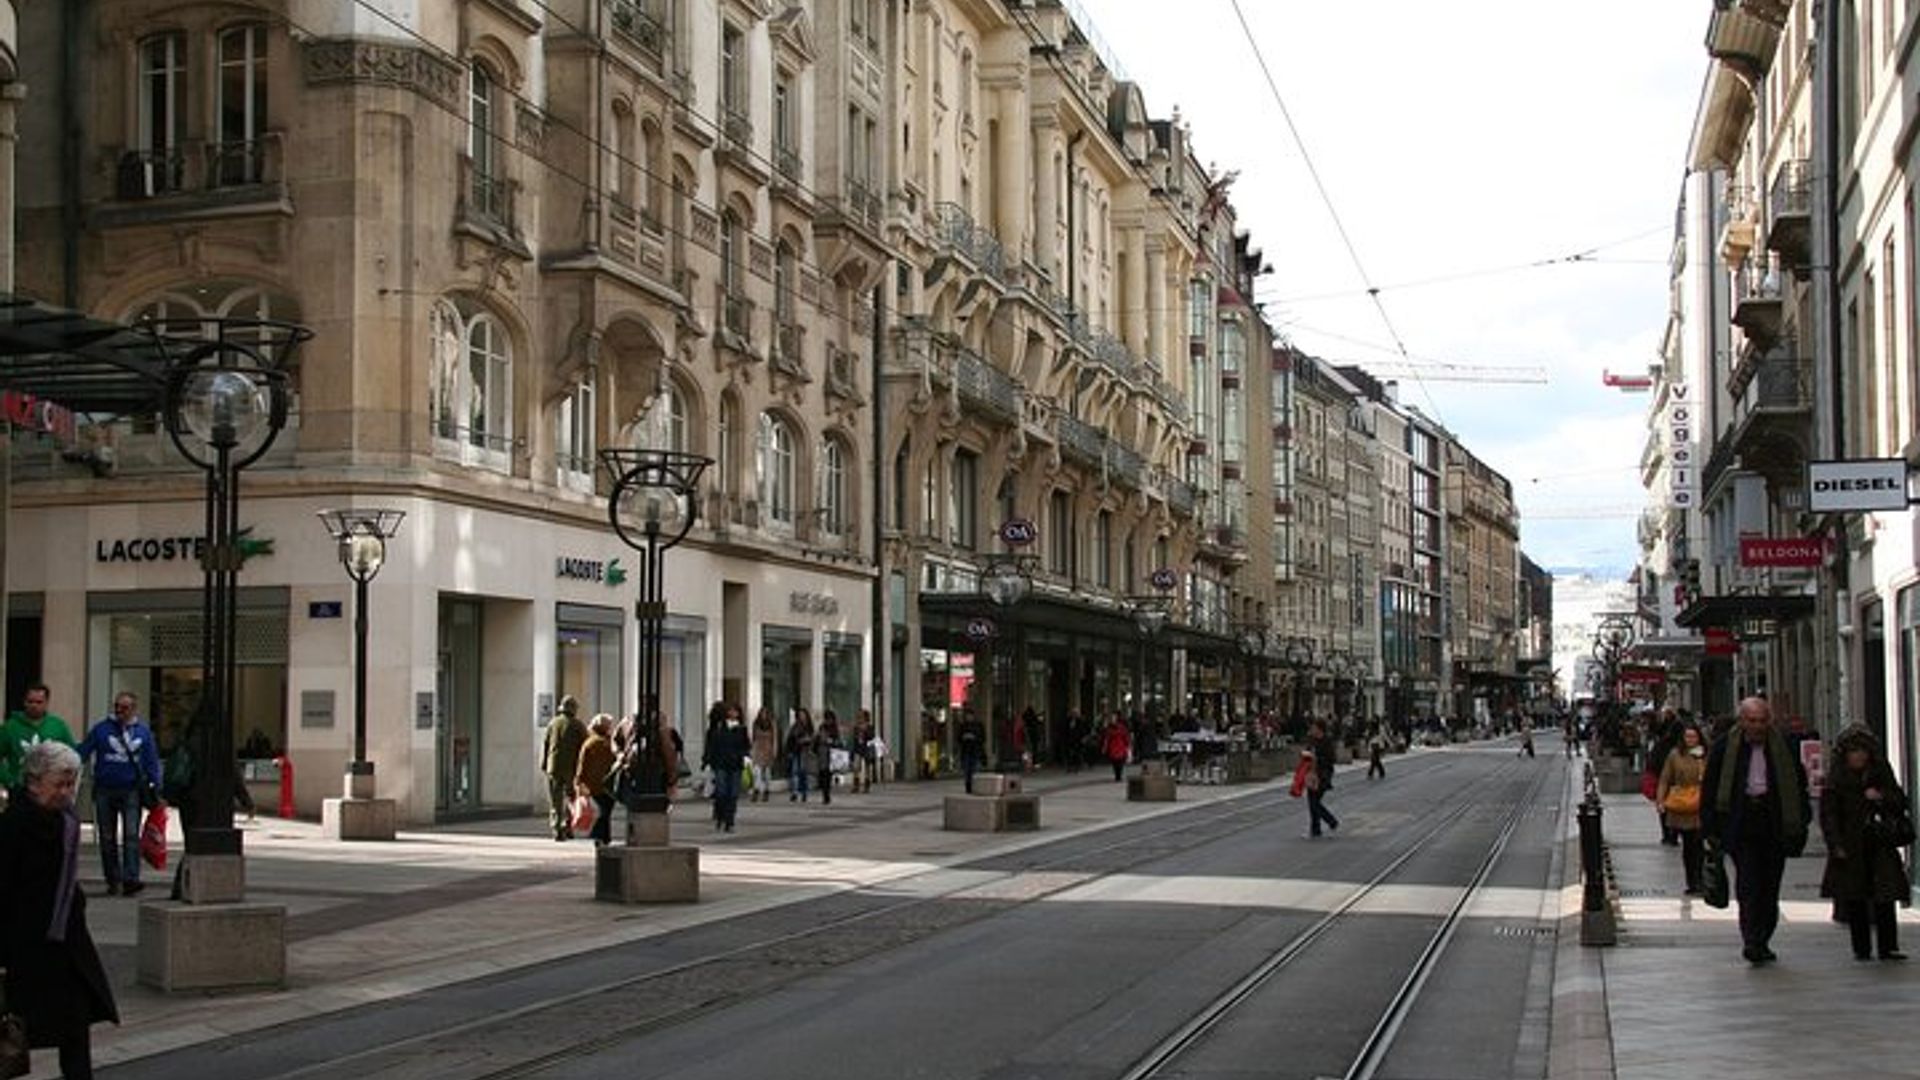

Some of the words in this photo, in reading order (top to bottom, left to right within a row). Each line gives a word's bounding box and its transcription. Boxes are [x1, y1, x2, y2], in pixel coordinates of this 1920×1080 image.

[1673, 386, 1690, 504] Vögele
[1814, 477, 1900, 492] DIESEL
[96, 537, 207, 562] LACOSTE
[1749, 547, 1821, 559] BELDONA
[556, 556, 603, 583] LACOSTE
[1745, 619, 1778, 635] WE
